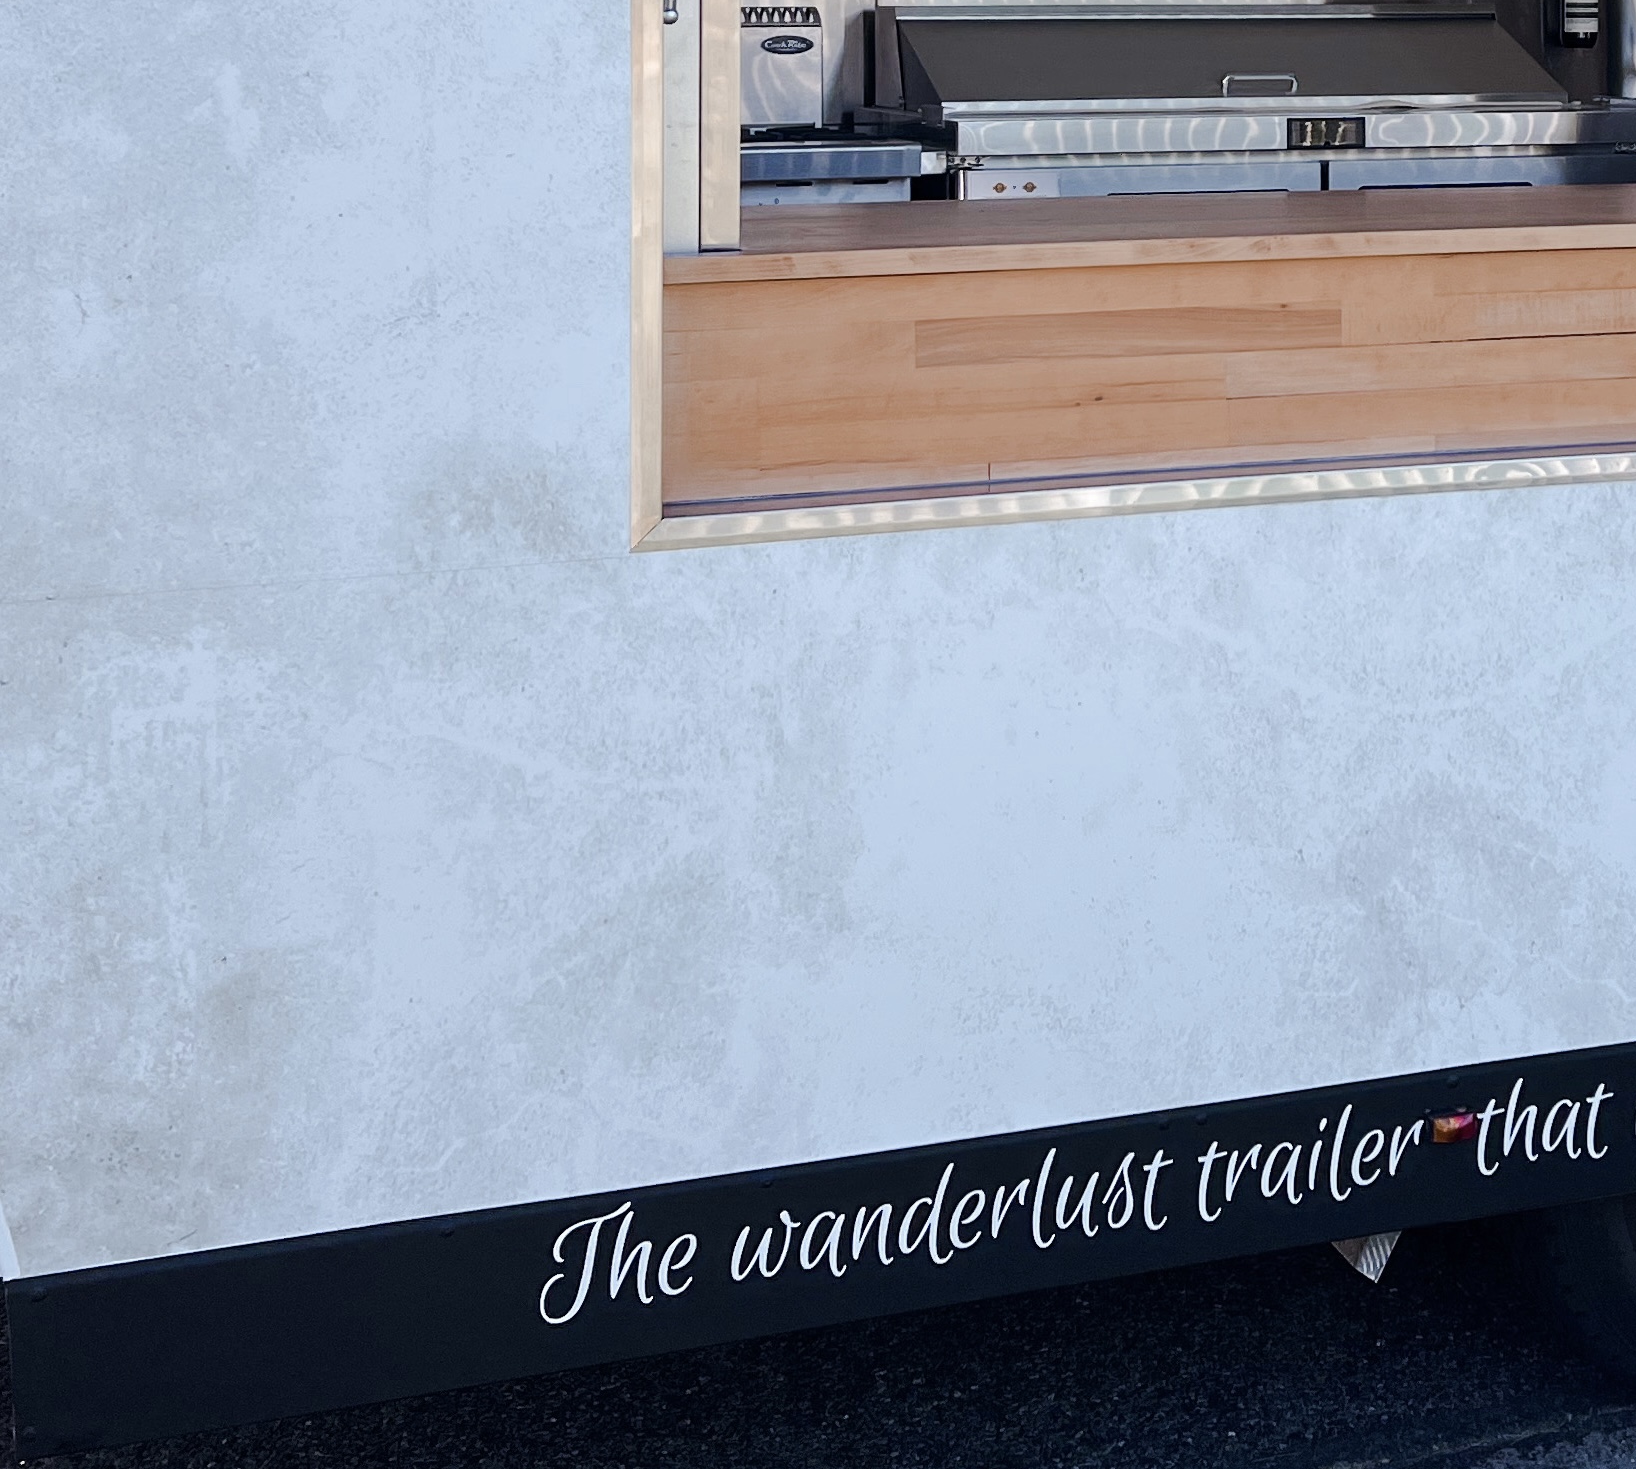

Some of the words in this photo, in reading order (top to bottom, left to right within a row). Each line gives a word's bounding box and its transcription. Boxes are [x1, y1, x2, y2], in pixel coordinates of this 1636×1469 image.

[539, 1201, 698, 1325] The
[730, 1147, 1174, 1281] wanderlust
[1197, 1103, 1425, 1222] trailer
[1476, 1077, 1615, 1176] that
